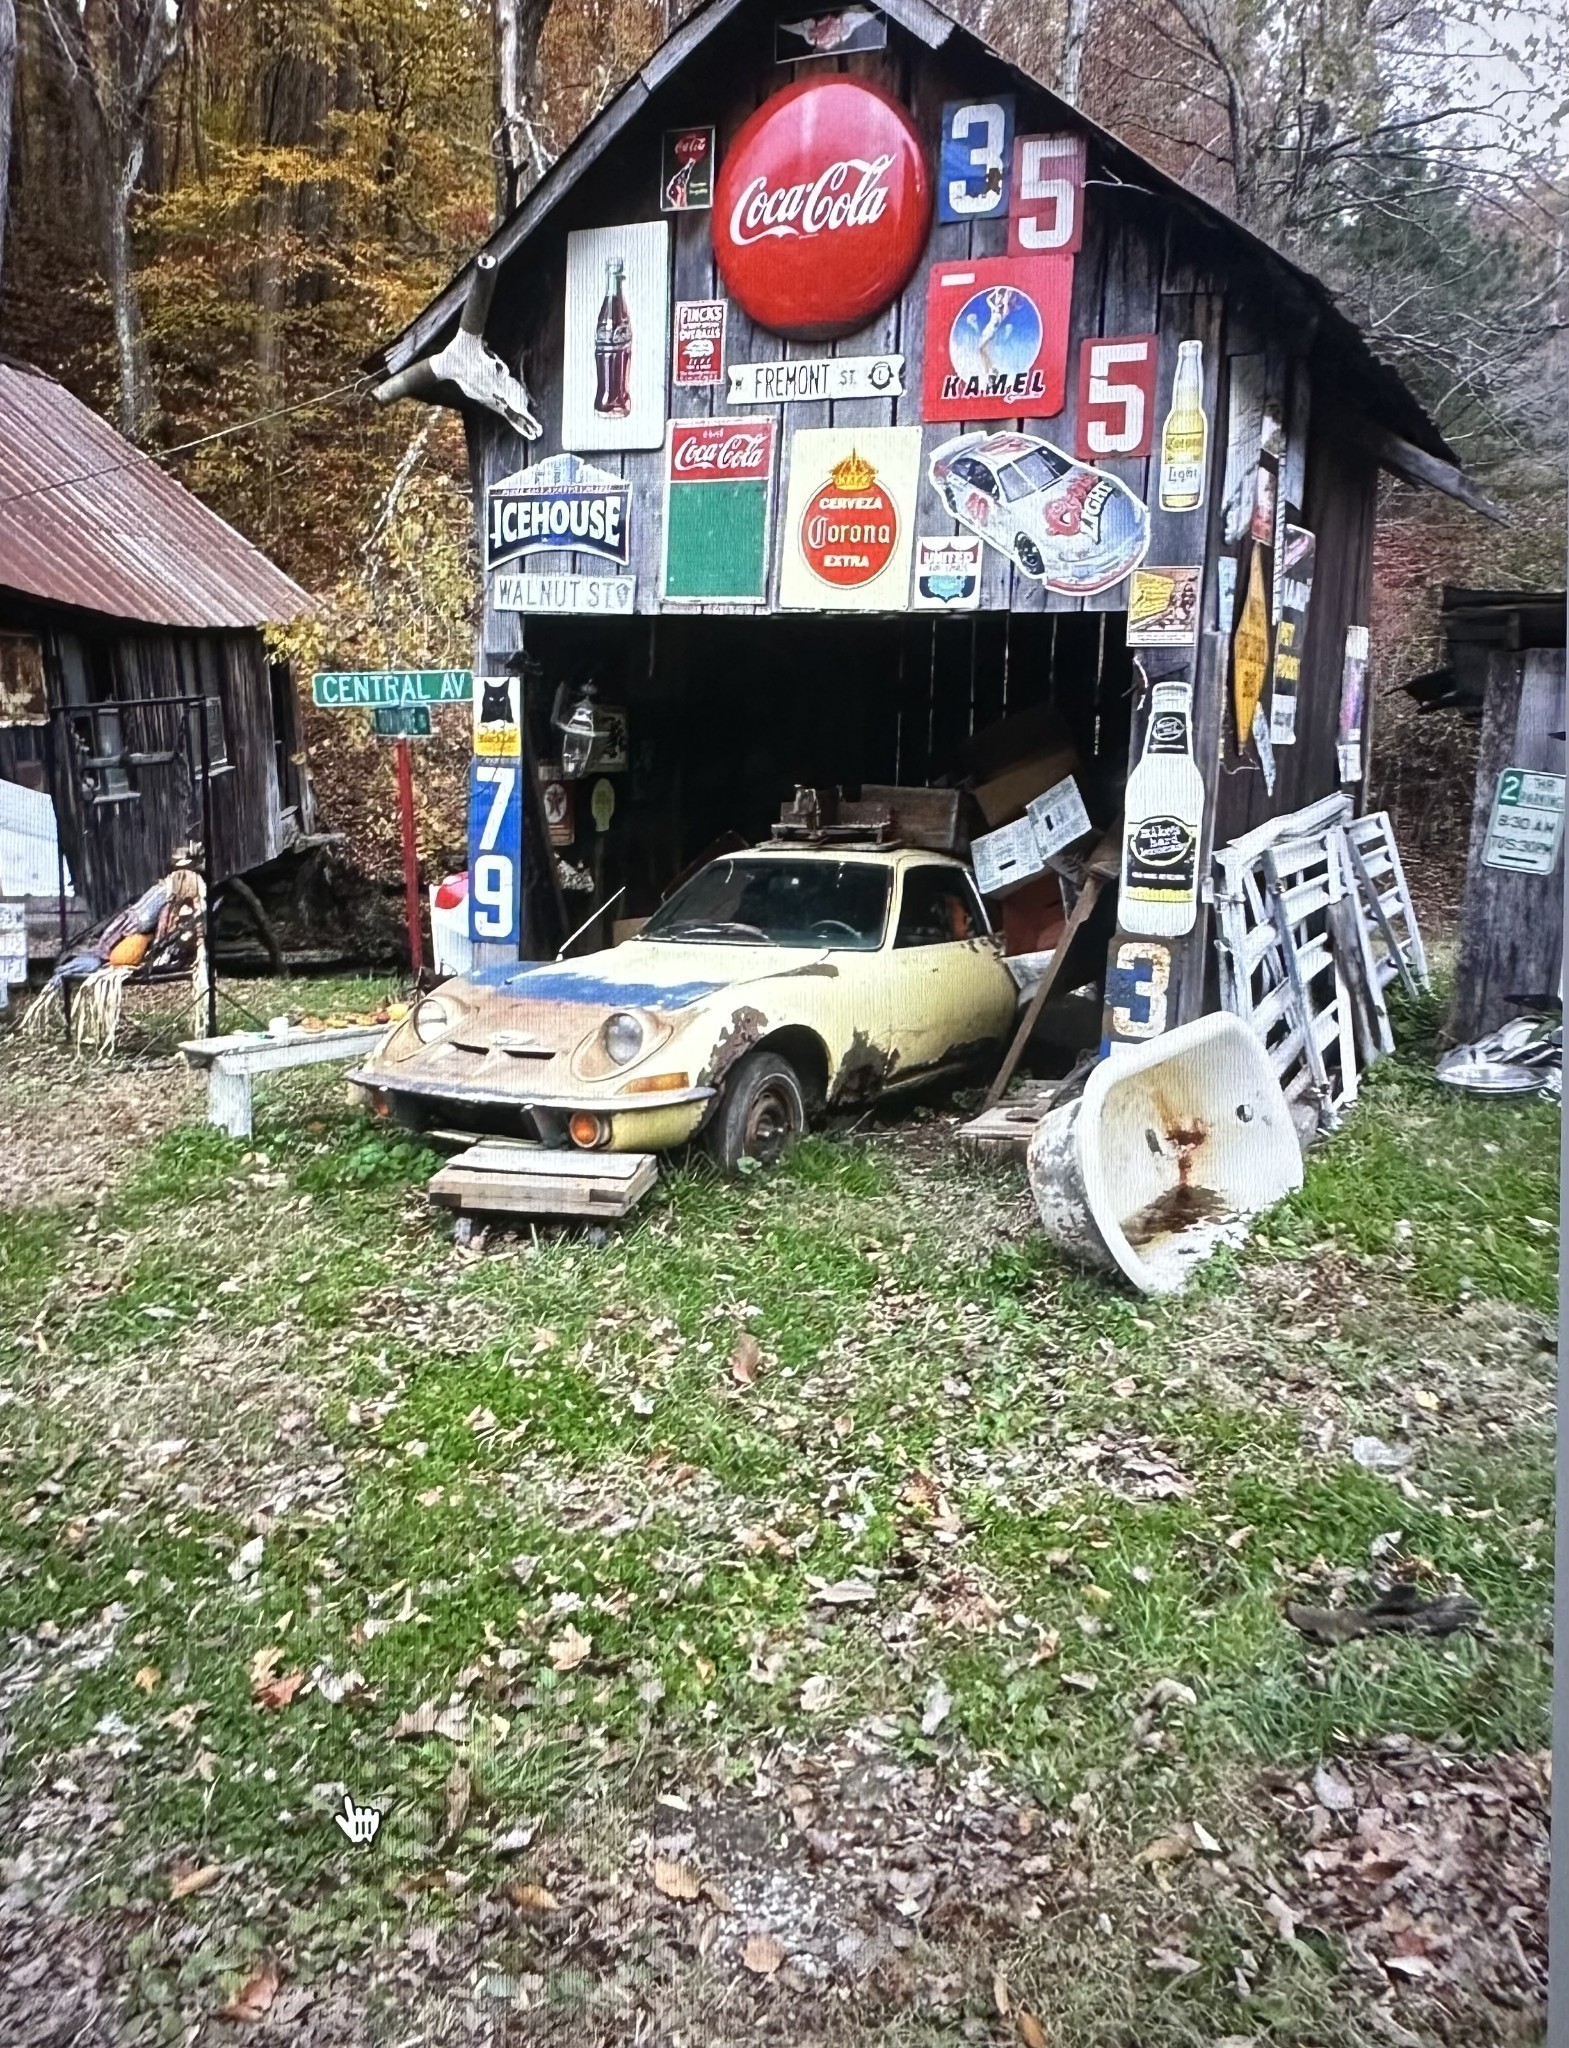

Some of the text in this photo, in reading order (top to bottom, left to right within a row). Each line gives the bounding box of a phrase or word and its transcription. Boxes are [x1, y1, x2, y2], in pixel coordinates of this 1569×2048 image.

[948, 103, 1006, 214] 3
[729, 153, 898, 246] Coca-Cola
[1018, 136, 1079, 250] 5
[755, 363, 830, 398] FREMONT
[941, 370, 1046, 402] KAMEL
[1086, 342, 1149, 453] 5
[674, 432, 769, 471] Coca-Cola
[489, 495, 621, 549] ICEHOUSE
[818, 496, 884, 510] CERVEZA
[807, 514, 891, 550] Corona
[823, 554, 870, 568] EXTRA
[499, 578, 581, 608] WALNUT
[322, 672, 465, 703] CENTRAL AV
[1501, 775, 1520, 801] 2
[476, 767, 516, 851] 7
[473, 854, 514, 938] 9
[1112, 942, 1172, 1039] 3
